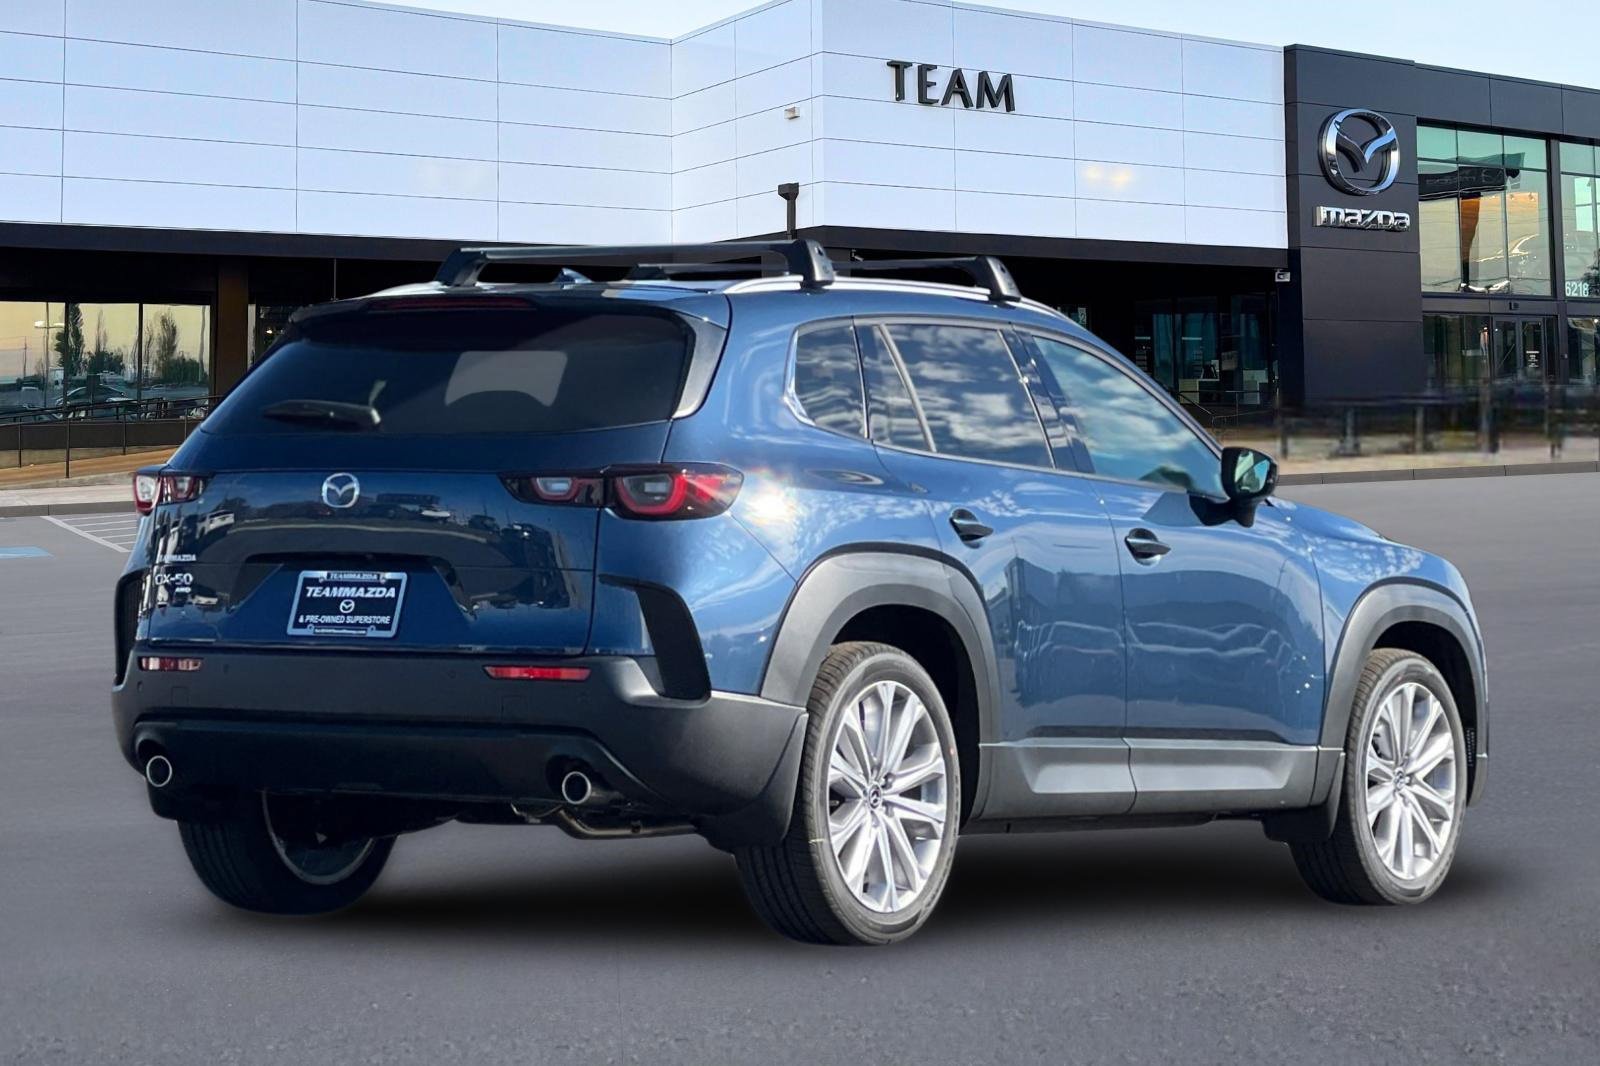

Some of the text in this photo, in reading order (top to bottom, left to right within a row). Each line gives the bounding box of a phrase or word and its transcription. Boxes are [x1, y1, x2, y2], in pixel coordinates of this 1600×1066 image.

[886, 60, 1015, 112] TEAM
[1565, 281, 1589, 297] 6218
[155, 573, 193, 585] CX-50
[306, 586, 396, 598] TEAMMAZDA
[305, 615, 345, 624] PRE-OWNED
[346, 615, 391, 624] SUPERSTORE
